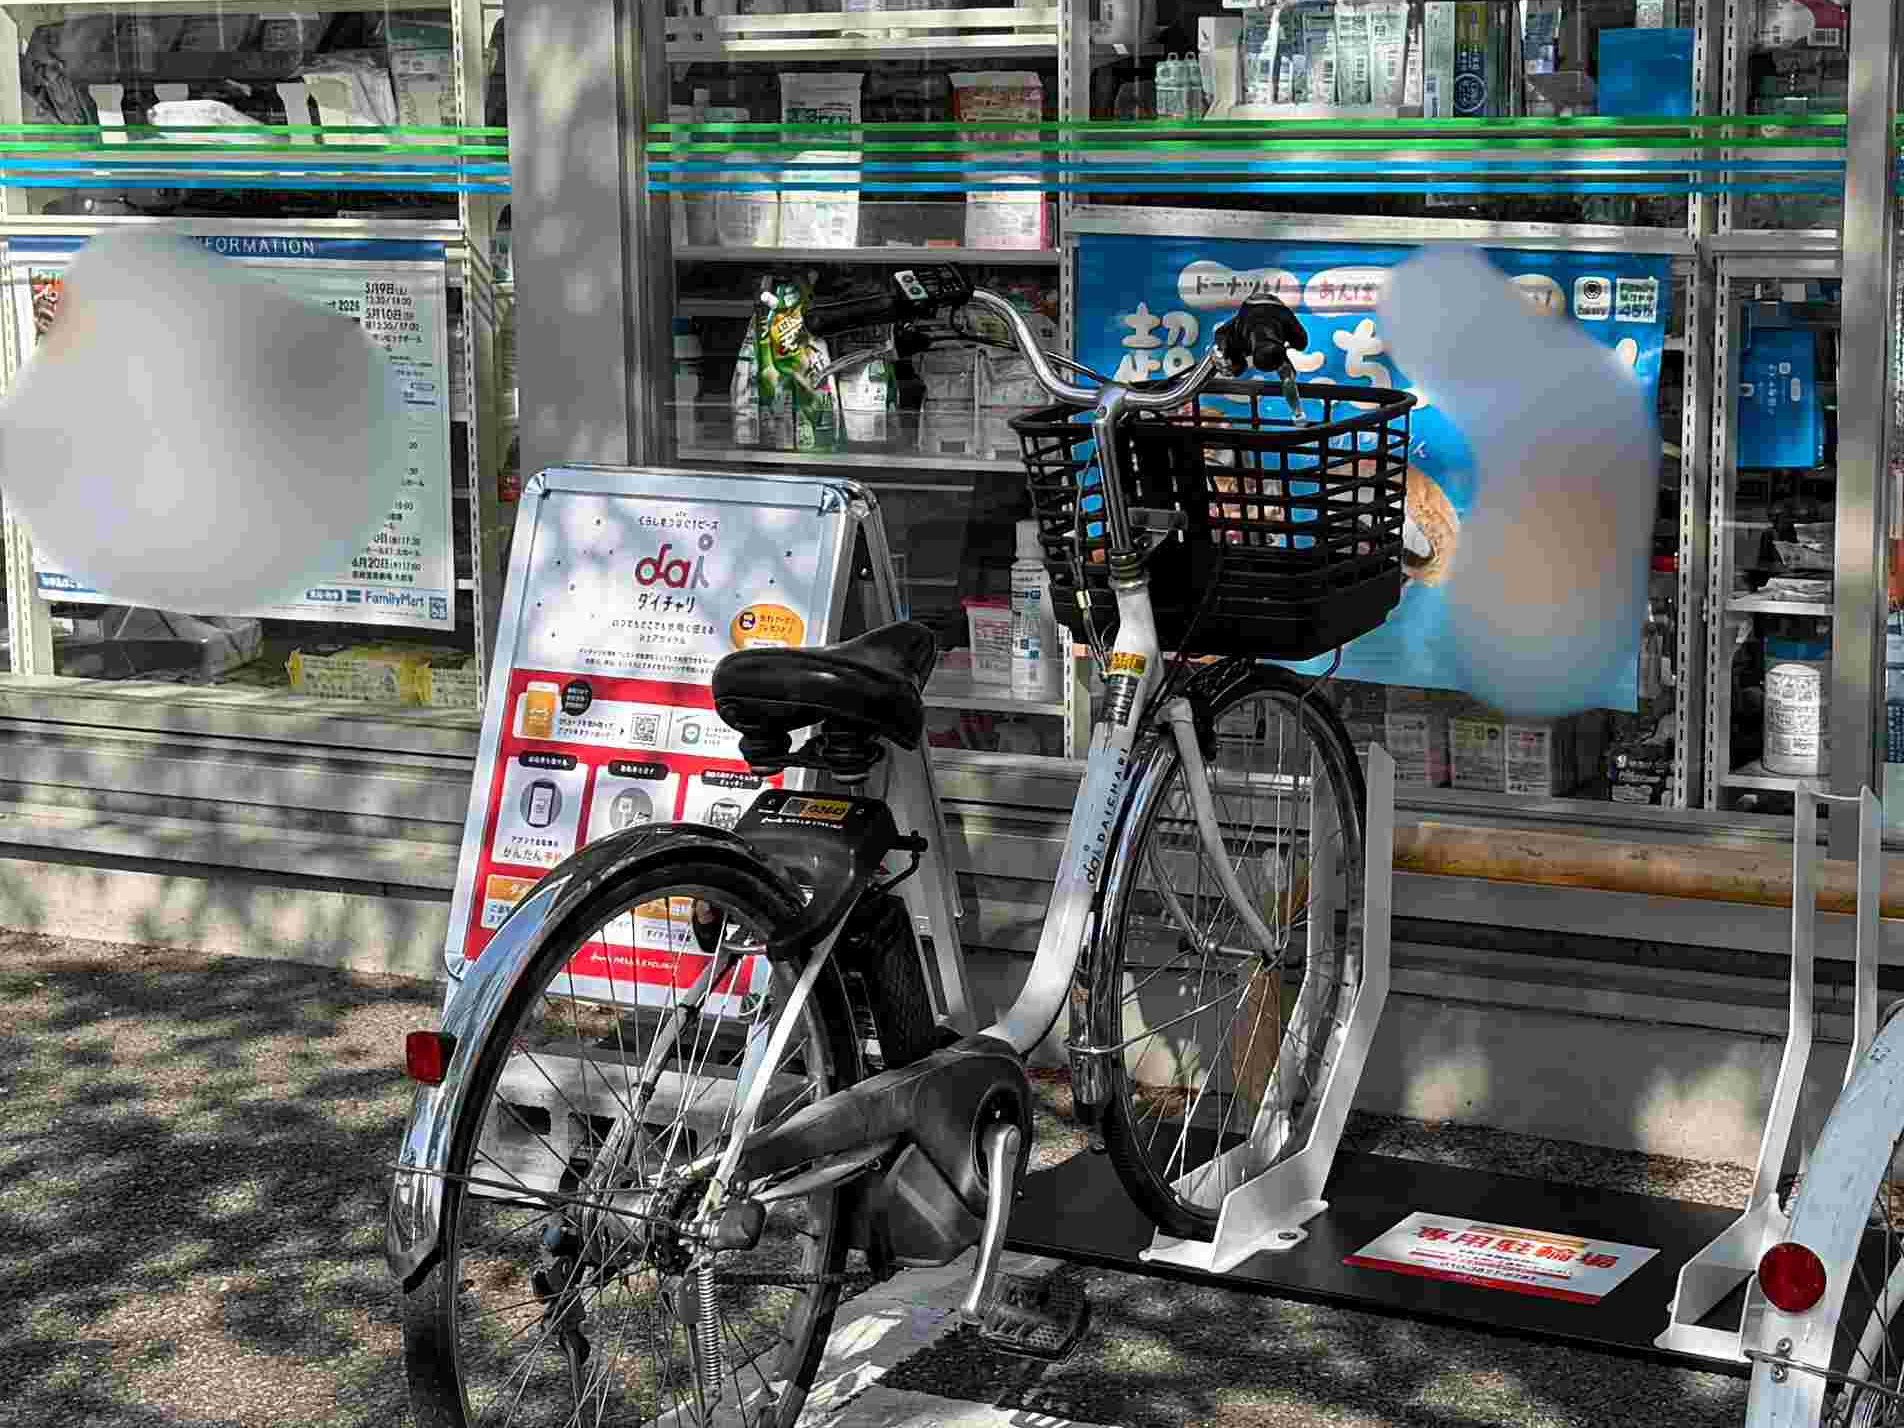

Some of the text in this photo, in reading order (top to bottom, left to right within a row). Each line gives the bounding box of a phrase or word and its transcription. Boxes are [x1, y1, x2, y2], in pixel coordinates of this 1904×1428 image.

[200, 235, 316, 255] FORMATION
[365, 590, 425, 608] FamilyMart
[638, 593, 696, 614] ダイチャリ
